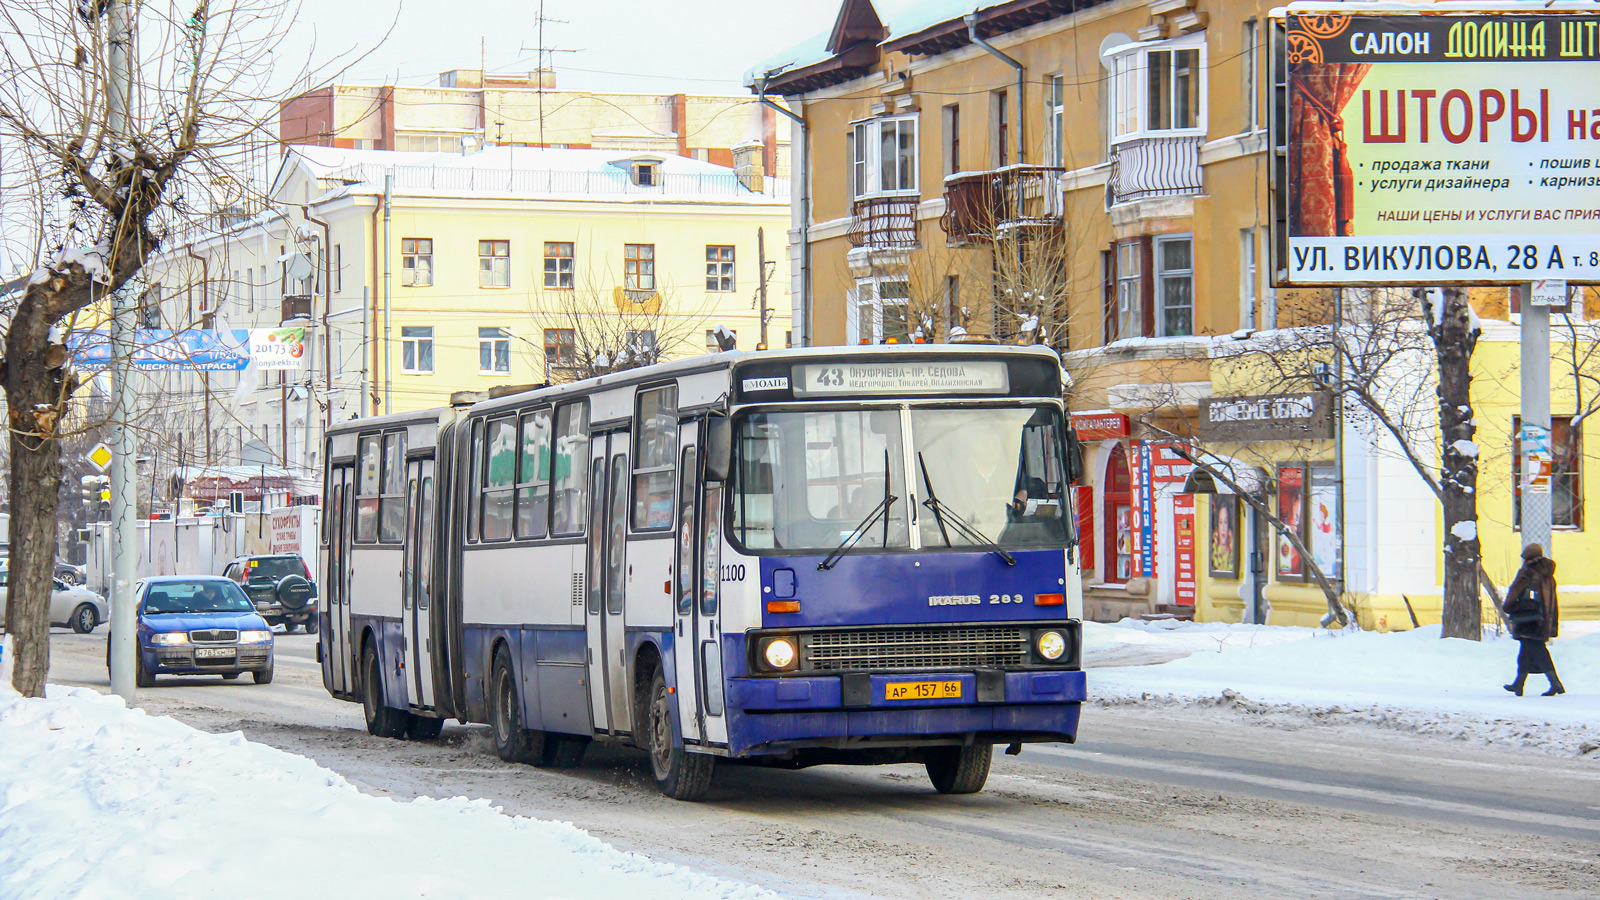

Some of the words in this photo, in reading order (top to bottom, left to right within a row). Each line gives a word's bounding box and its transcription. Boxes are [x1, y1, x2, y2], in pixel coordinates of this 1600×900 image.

[1350, 31, 1430, 54] САЛОН
[1444, 20, 1546, 58] ДОЛИНА
[1560, 21, 1600, 57] ШТ
[1362, 88, 1549, 143] ШТОРЫ
[1371, 160, 1441, 173] продажа
[1446, 160, 1490, 171] ткани
[1540, 159, 1591, 169] пошив
[1370, 178, 1422, 192] услуги
[1424, 176, 1510, 192] дизайнера
[1377, 210, 1420, 221] НАШИ
[1423, 210, 1462, 223] ЦЕНЫ
[1465, 210, 1475, 221] И
[1478, 209, 1532, 221] УСЛУГИ
[1534, 209, 1562, 220] ВАС
[1293, 246, 1334, 271] УЛ.
[1344, 245, 1498, 273] ВИКУЛОВА,
[1507, 244, 1538, 269] 28
[1546, 244, 1565, 269] А
[816, 367, 845, 387] 43
[1131, 445, 1141, 572] РЕМОНТ
[721, 564, 746, 582] 1100
[928, 594, 981, 606] IKARUS
[989, 593, 1024, 604] 283
[914, 683, 937, 697] 157
[944, 682, 957, 692] 66
